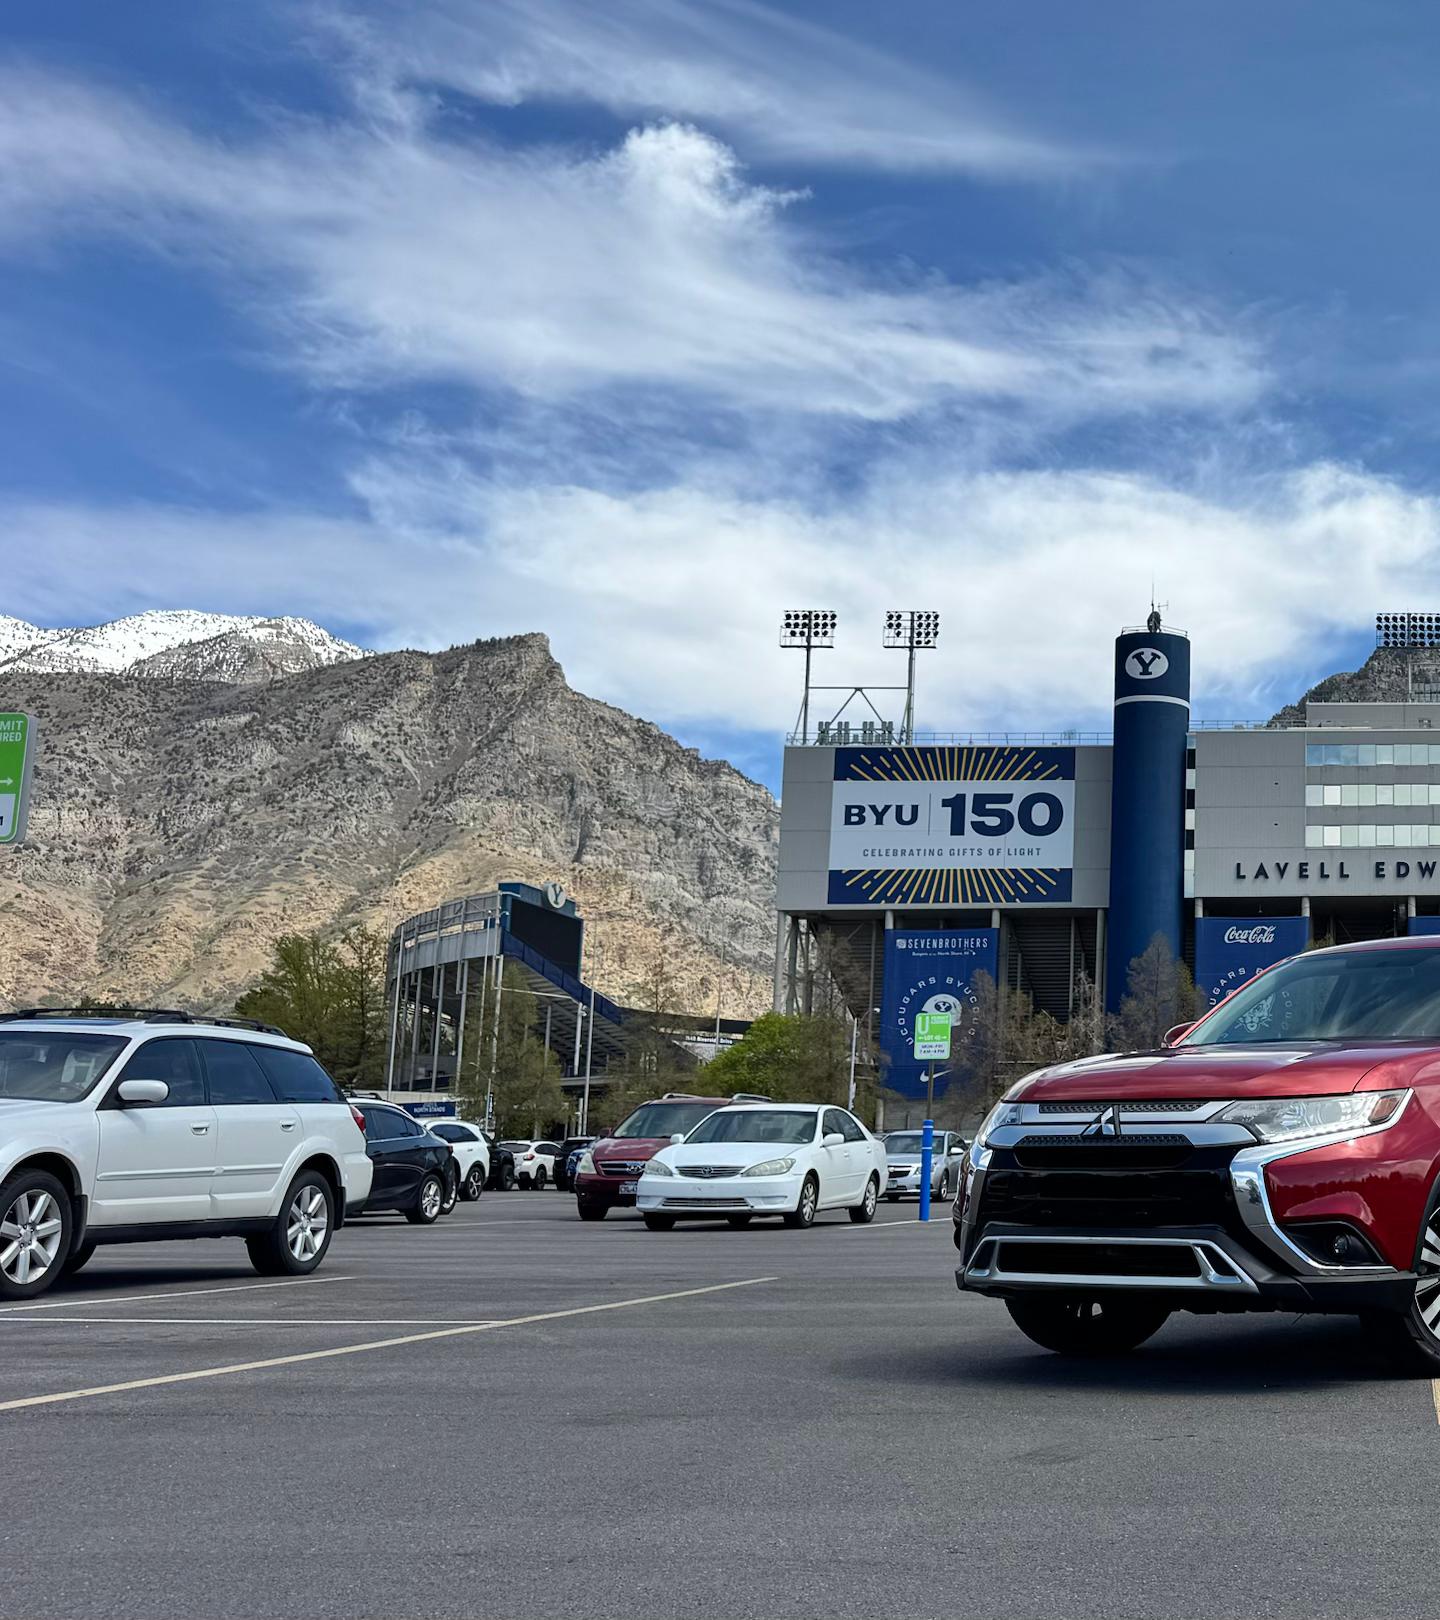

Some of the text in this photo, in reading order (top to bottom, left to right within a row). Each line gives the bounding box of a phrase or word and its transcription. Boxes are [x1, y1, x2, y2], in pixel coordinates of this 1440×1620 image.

[0, 720, 24, 731] MIT
[843, 791, 1064, 837] BYU 150
[862, 846, 1042, 858] CELEBRATING GIFTS OF LIGHT
[1236, 861, 1350, 880] LAVELL
[1224, 925, 1277, 944] Coca-Cola
